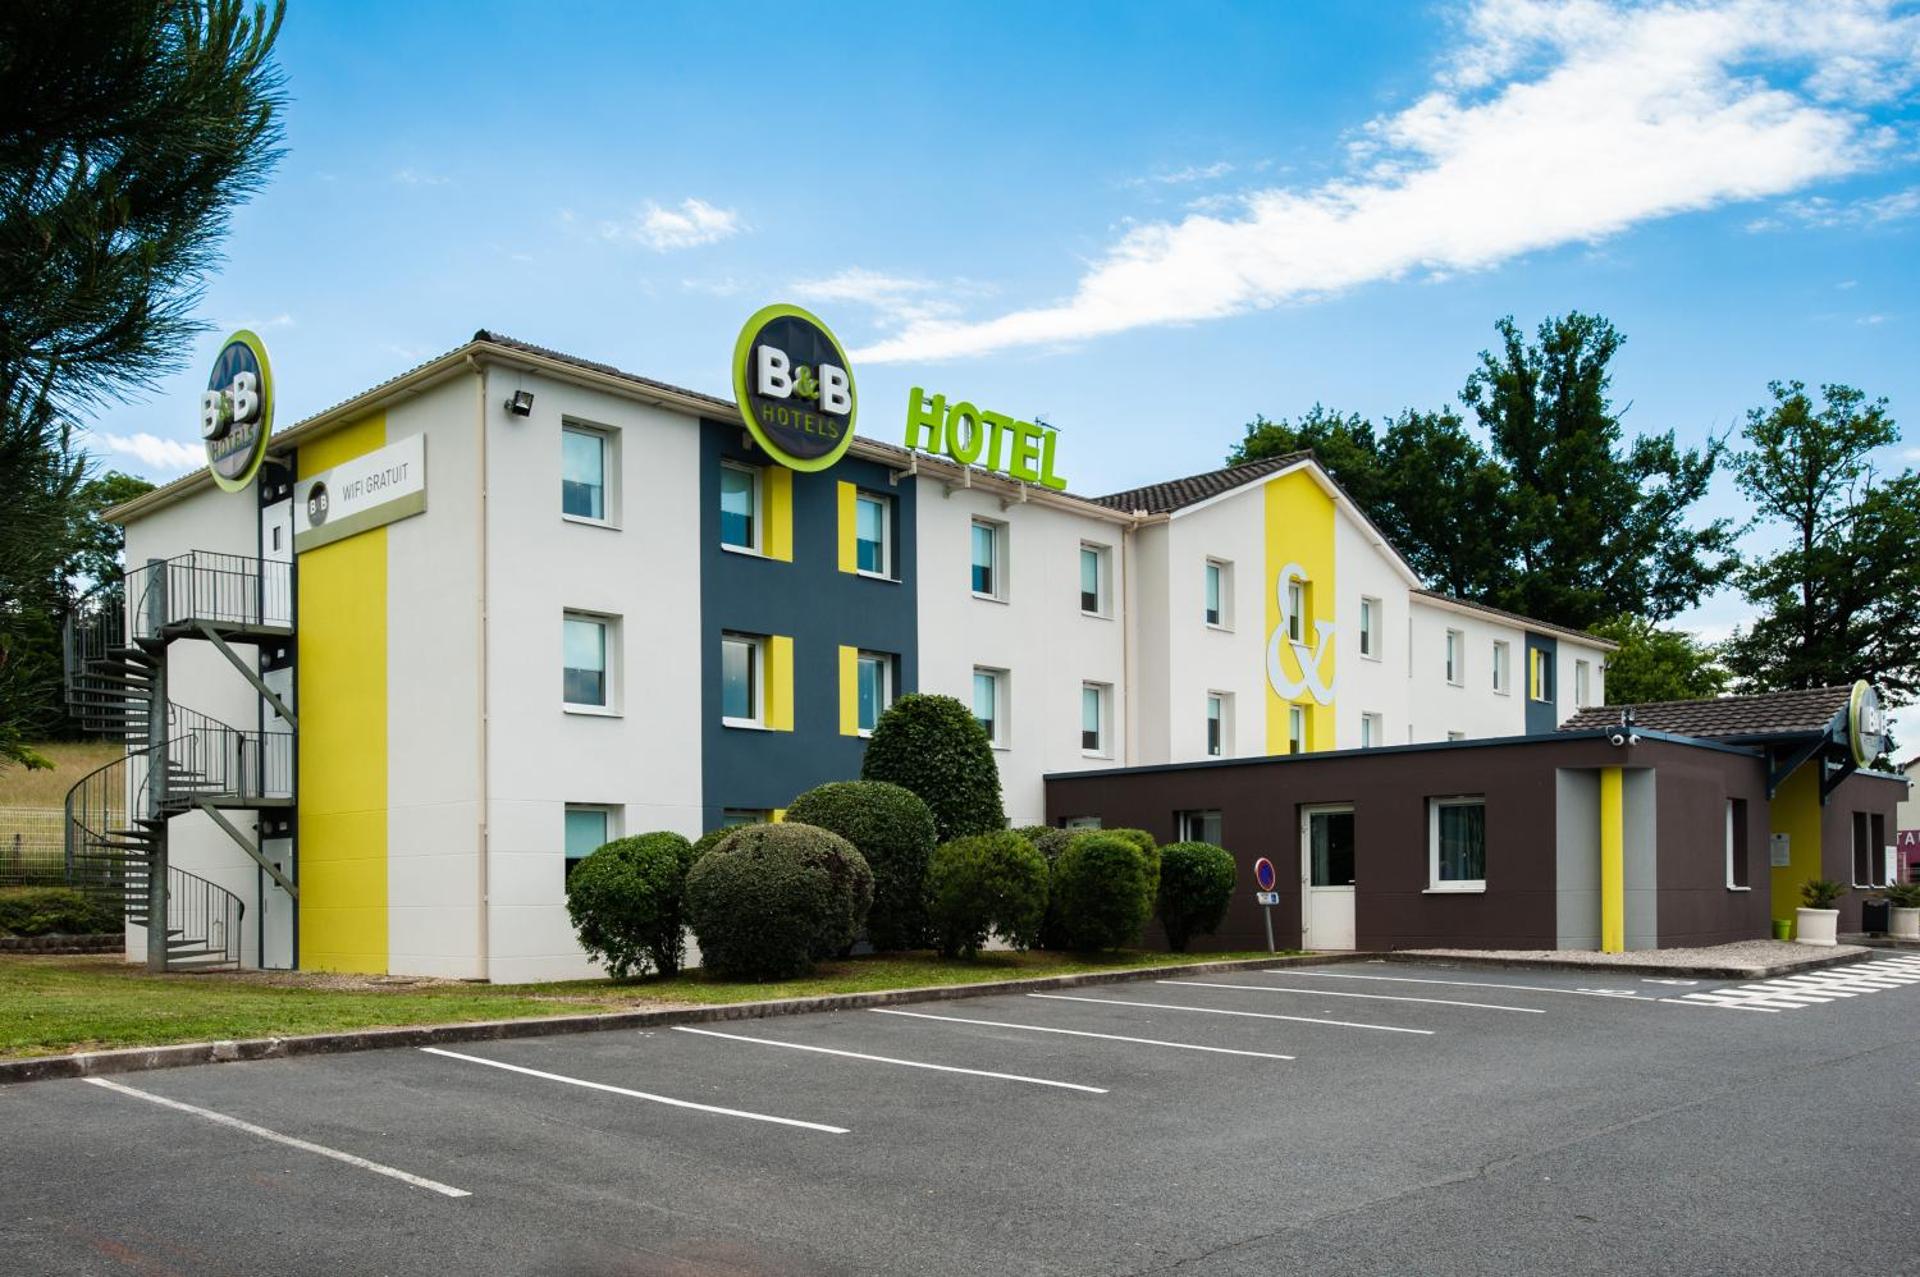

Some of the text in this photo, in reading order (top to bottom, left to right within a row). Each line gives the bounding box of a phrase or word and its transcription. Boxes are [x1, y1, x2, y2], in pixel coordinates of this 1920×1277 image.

[758, 344, 851, 415] B&B
[762, 405, 839, 439] HOTELS
[905, 387, 1067, 490] HOTEL
[342, 463, 408, 501] WIFI GRATUIT
[310, 495, 327, 514] BB
